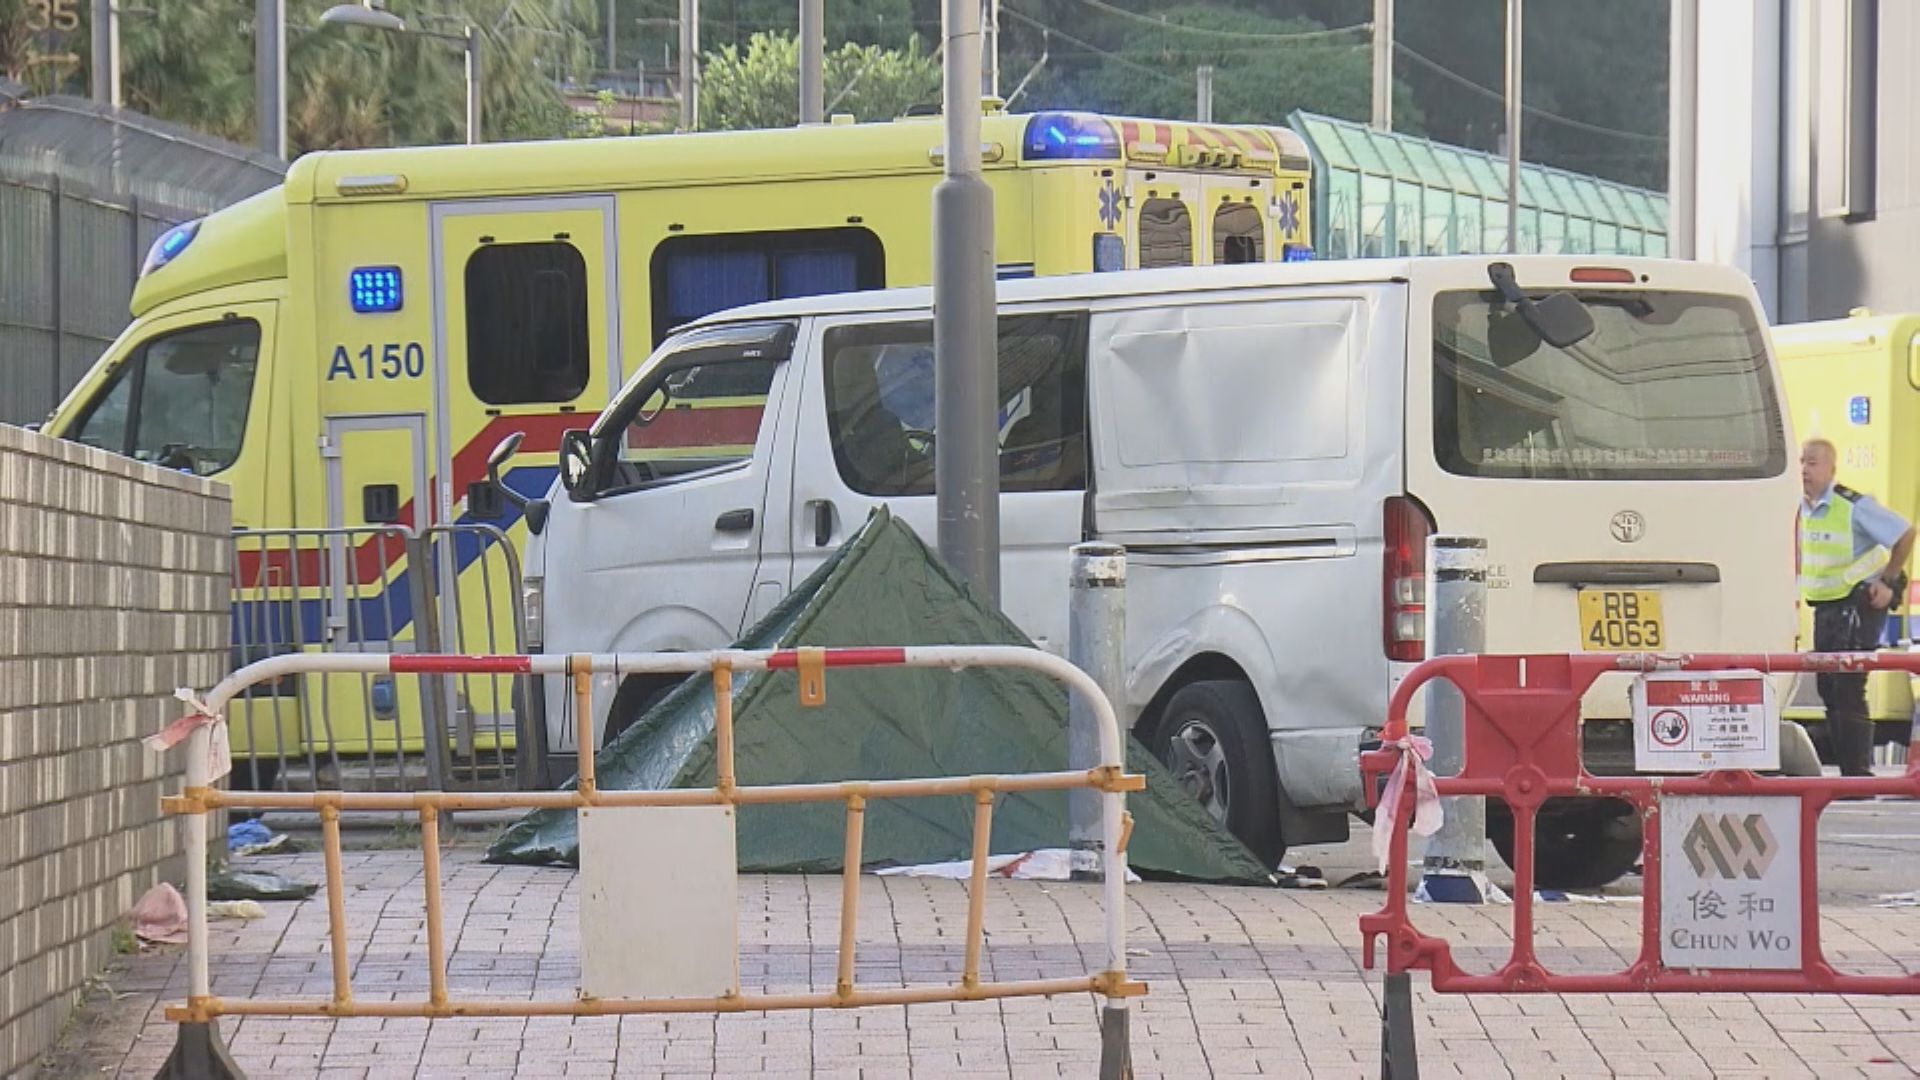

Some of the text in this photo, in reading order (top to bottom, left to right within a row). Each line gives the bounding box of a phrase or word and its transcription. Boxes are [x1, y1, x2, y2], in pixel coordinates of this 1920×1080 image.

[25, 0, 79, 31] 35
[327, 342, 424, 381] A150
[1604, 592, 1639, 619] RB
[1590, 619, 1660, 647] 4063
[1679, 692, 1731, 704] WARNING
[1687, 889, 1775, 921] 俊和
